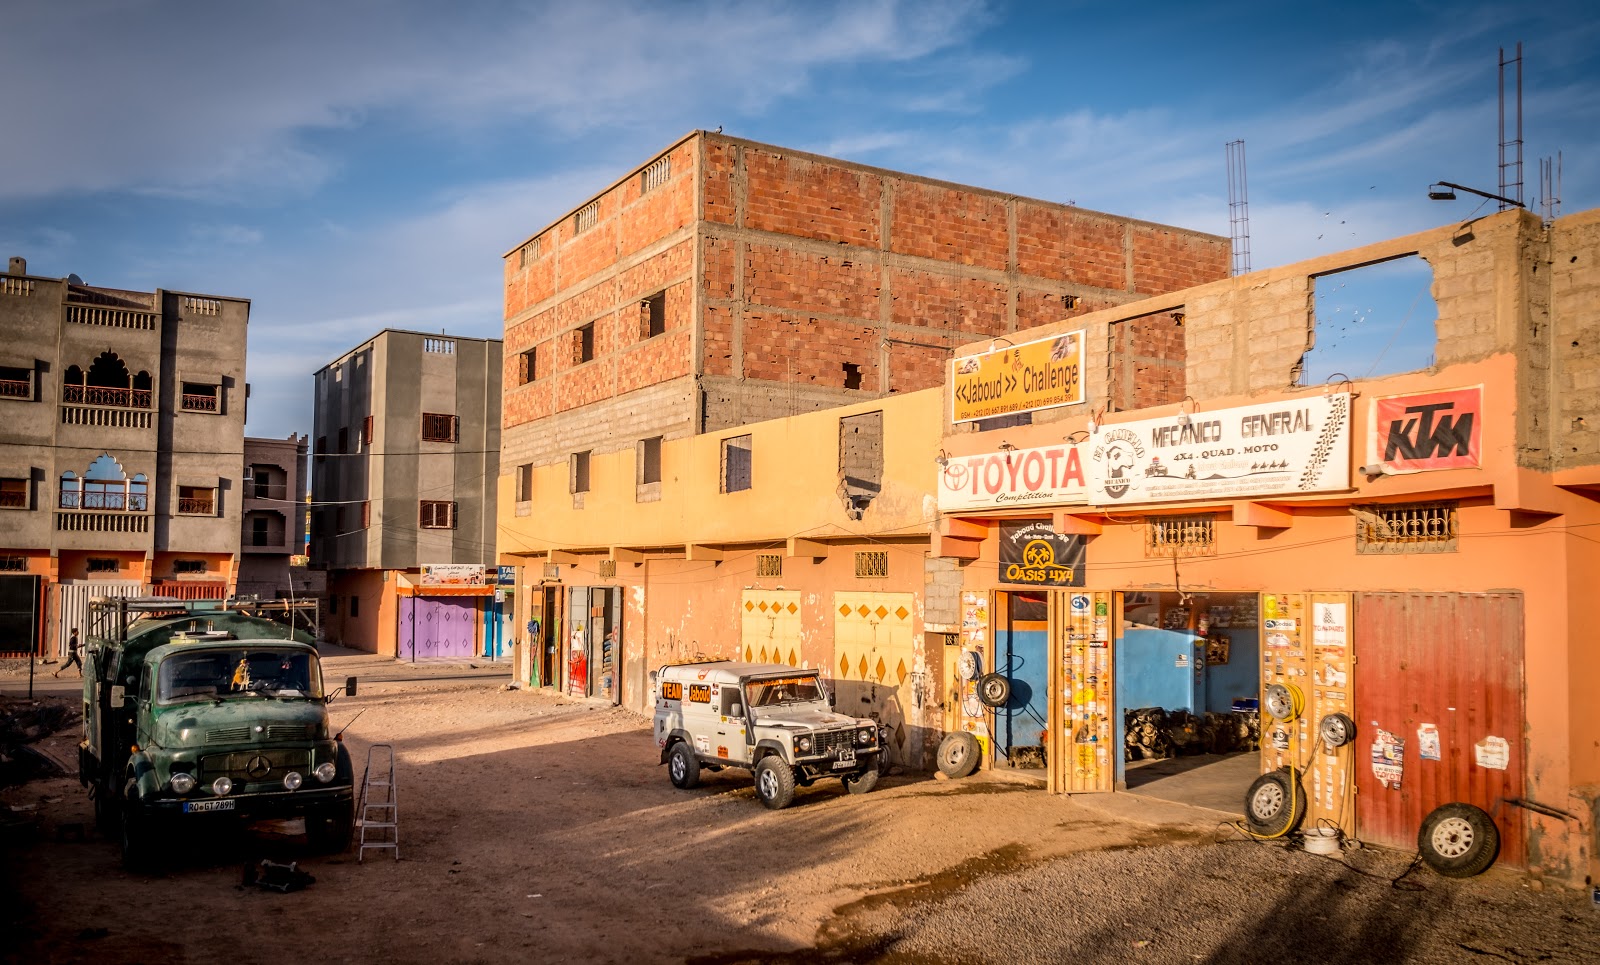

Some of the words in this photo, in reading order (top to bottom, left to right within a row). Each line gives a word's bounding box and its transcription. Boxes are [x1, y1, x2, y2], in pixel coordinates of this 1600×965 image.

[1023, 362, 1078, 394] Challenge
[1241, 408, 1314, 438] GENERAL
[1383, 401, 1475, 462] KTM
[1201, 448, 1235, 460] QUAD
[1243, 443, 1279, 454] MOTO
[967, 447, 1086, 496] TOYOTA
[995, 490, 1054, 503] Compétition
[662, 682, 683, 700] TEAM
[689, 685, 712, 704] Jaboud
[188, 802, 199, 812] RO
[204, 801, 214, 811] GT
